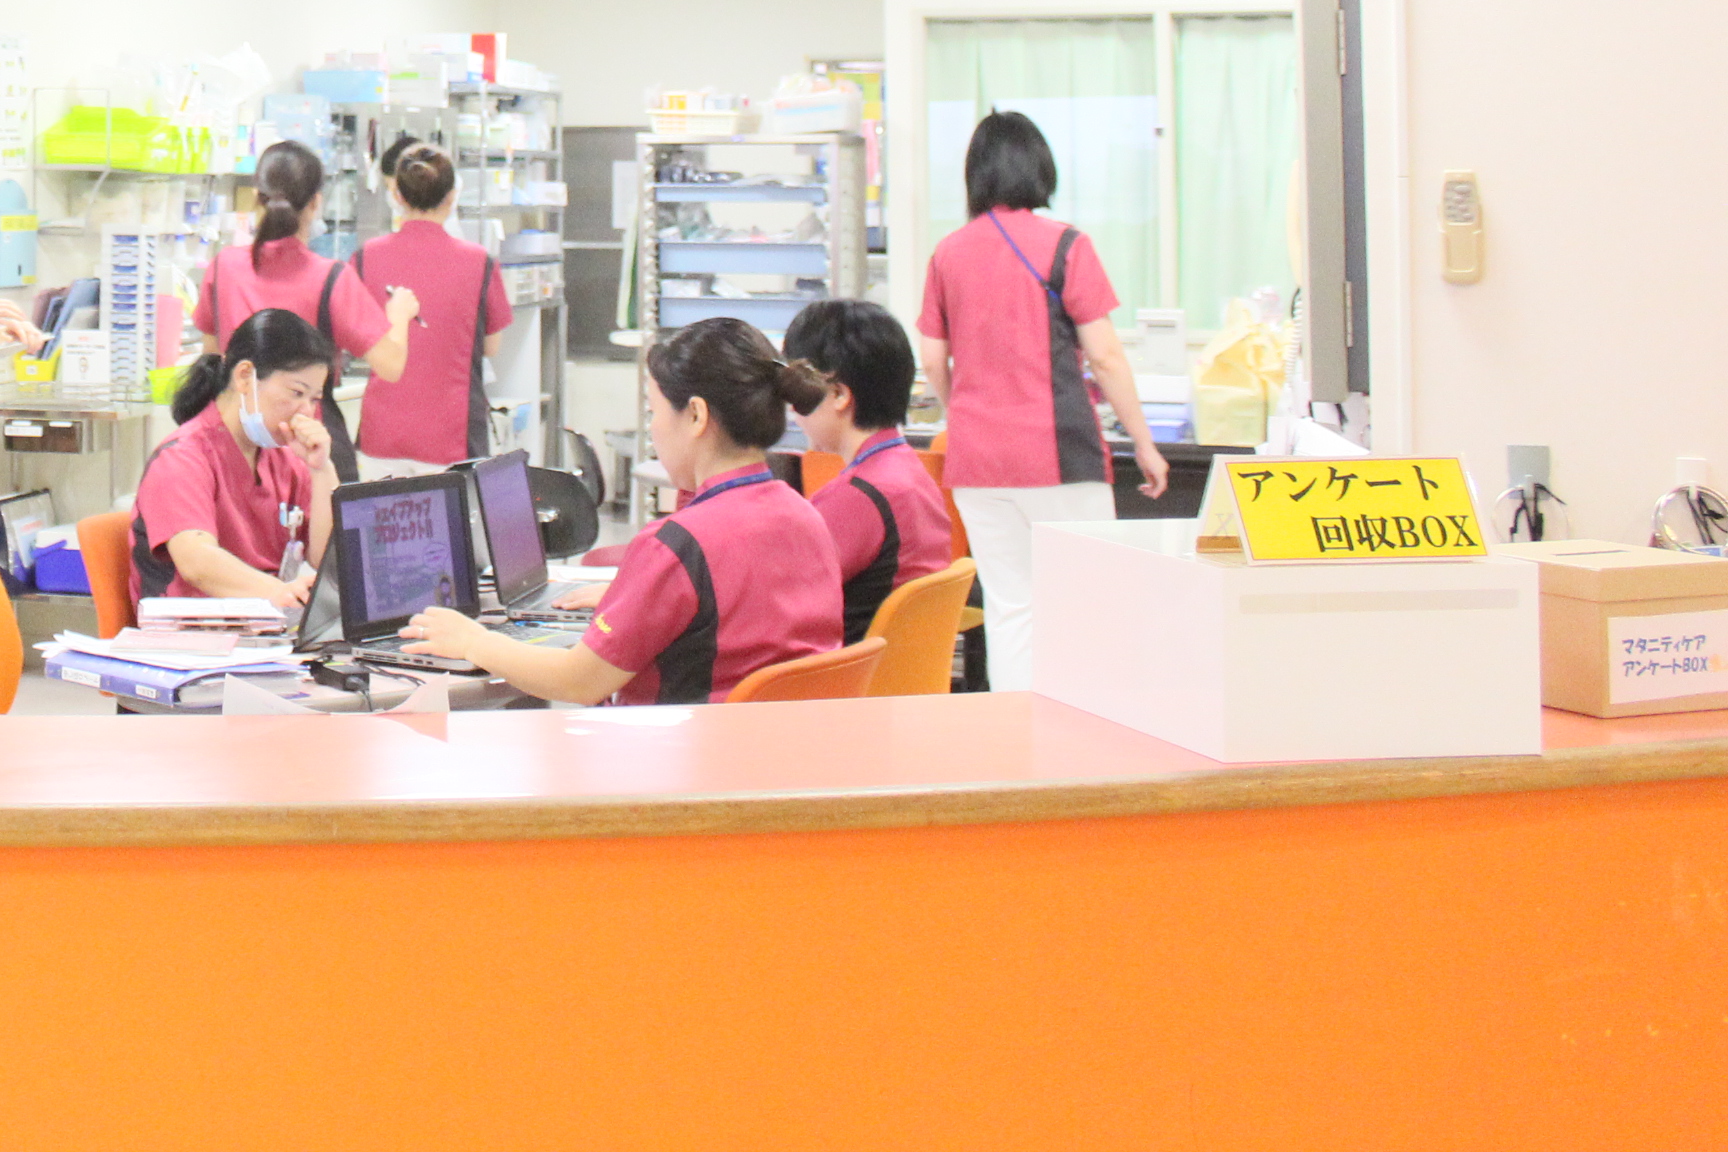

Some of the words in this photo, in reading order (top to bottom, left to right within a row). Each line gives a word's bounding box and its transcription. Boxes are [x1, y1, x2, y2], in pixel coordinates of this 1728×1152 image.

[1236, 464, 1440, 503] アンケート
[1309, 513, 1480, 553] 回収BOX
[1621, 634, 1707, 655] マタニティケア
[1622, 656, 1709, 677] アンケートBOX
